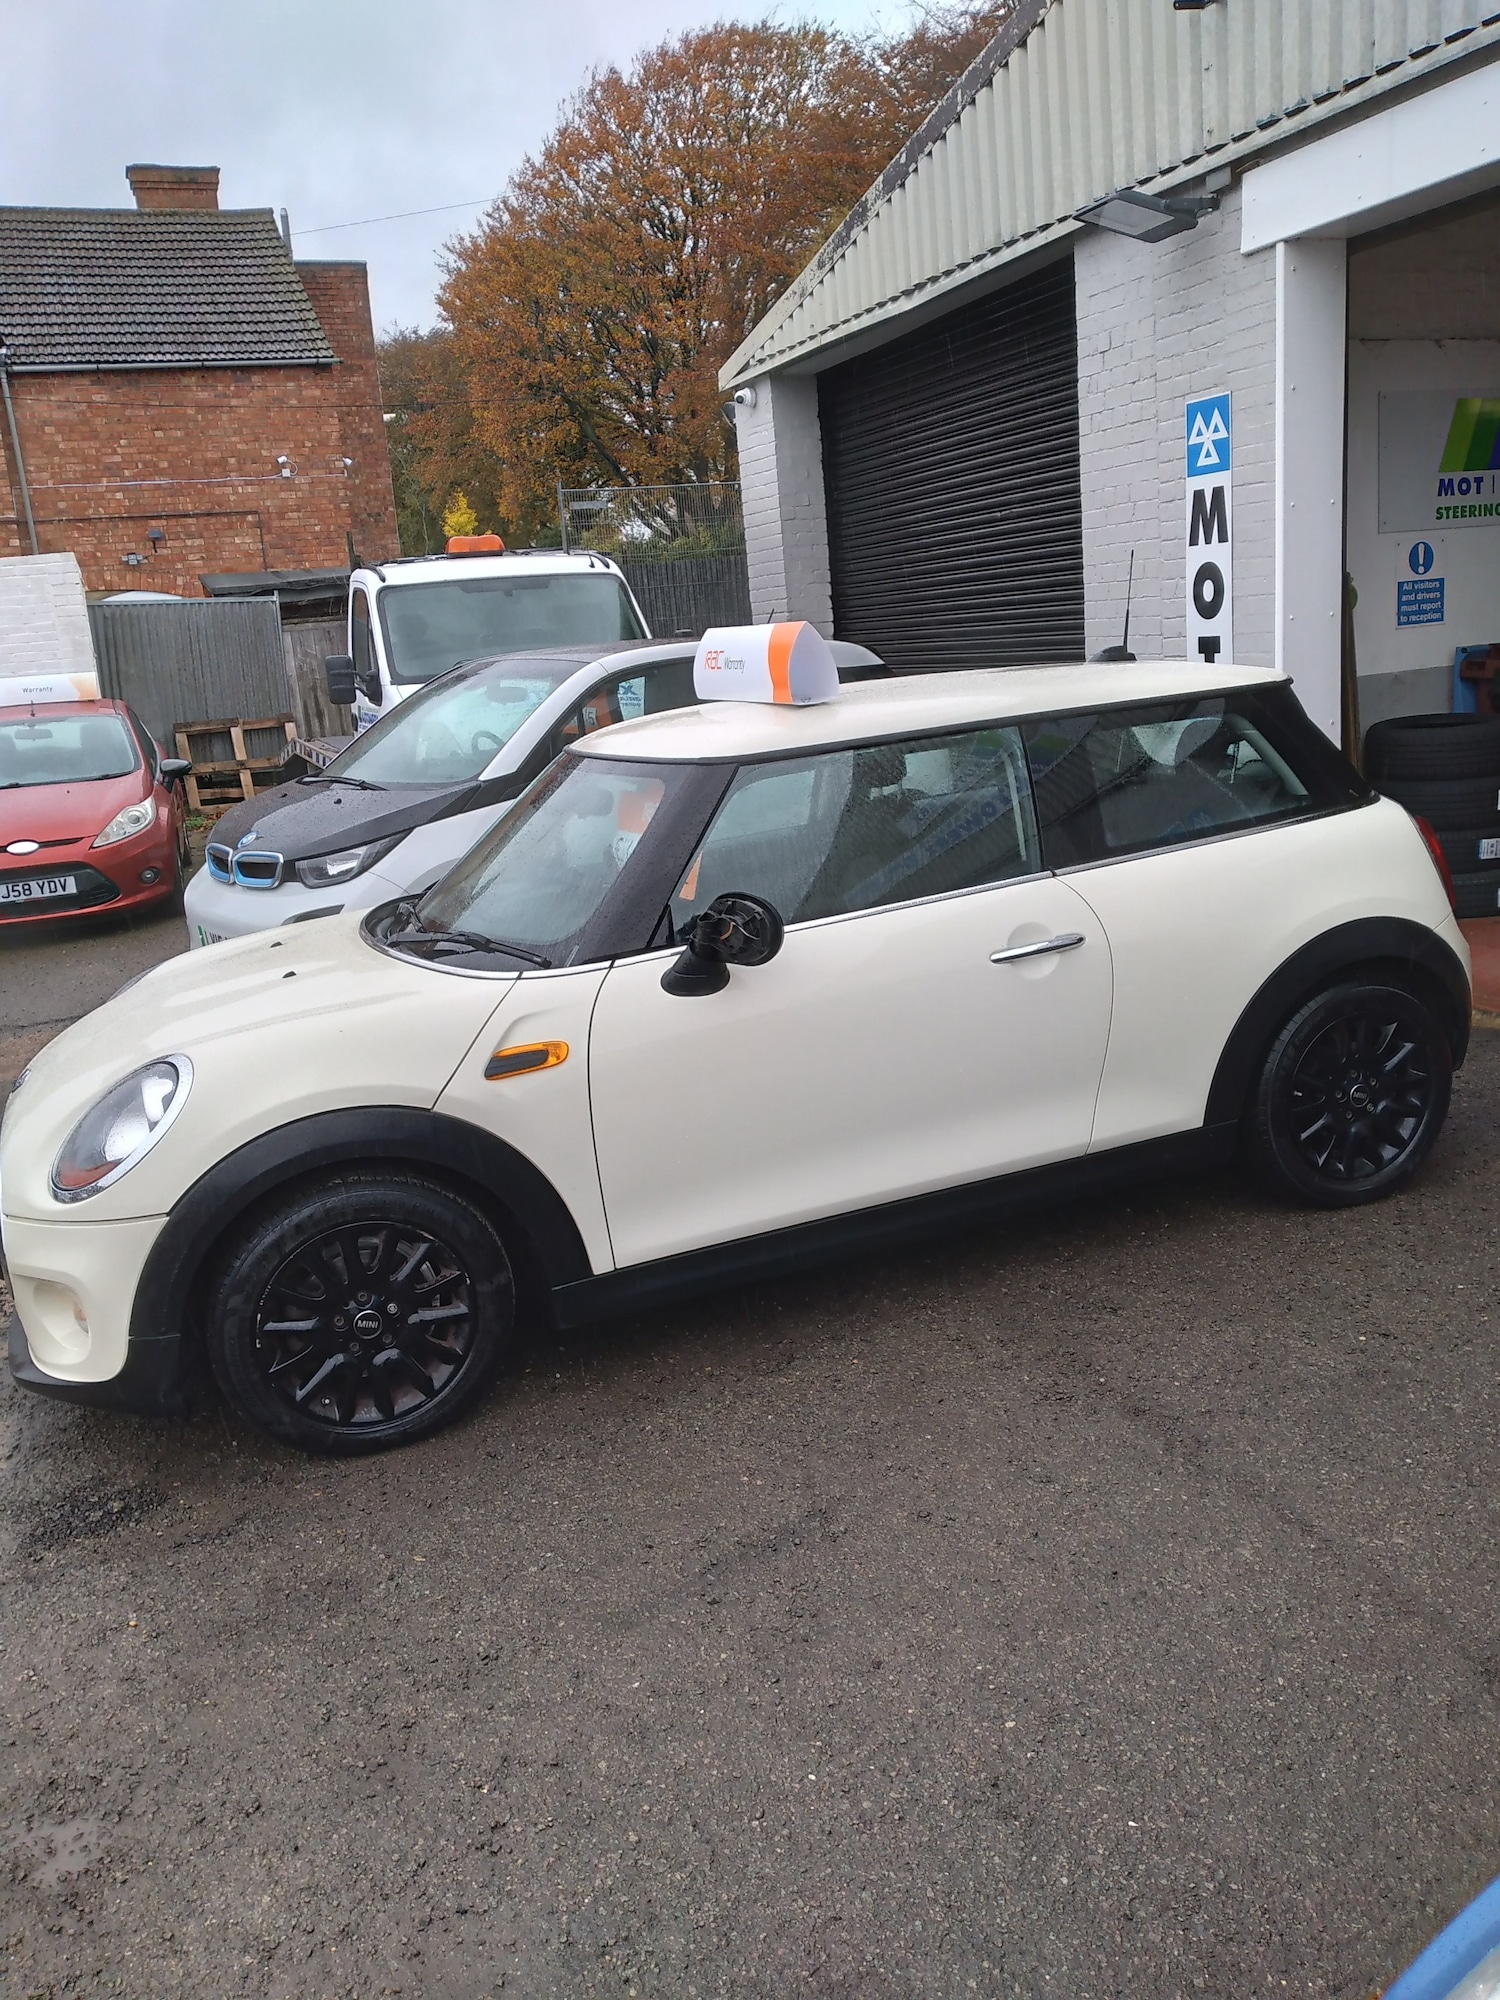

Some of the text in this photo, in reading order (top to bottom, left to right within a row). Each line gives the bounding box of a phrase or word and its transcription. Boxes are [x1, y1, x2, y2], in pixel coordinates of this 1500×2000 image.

[1437, 476, 1484, 497] MOT
[1188, 485, 1229, 664] MOT
[1402, 580, 1440, 591] All visitors
[1401, 591, 1441, 602] and drivers
[1401, 601, 1441, 612] must report
[1400, 611, 1442, 622] to reception
[724, 656, 746, 674] Warranty
[1, 878, 67, 899] J58 YDV
[357, 1319, 378, 1329] MINI
